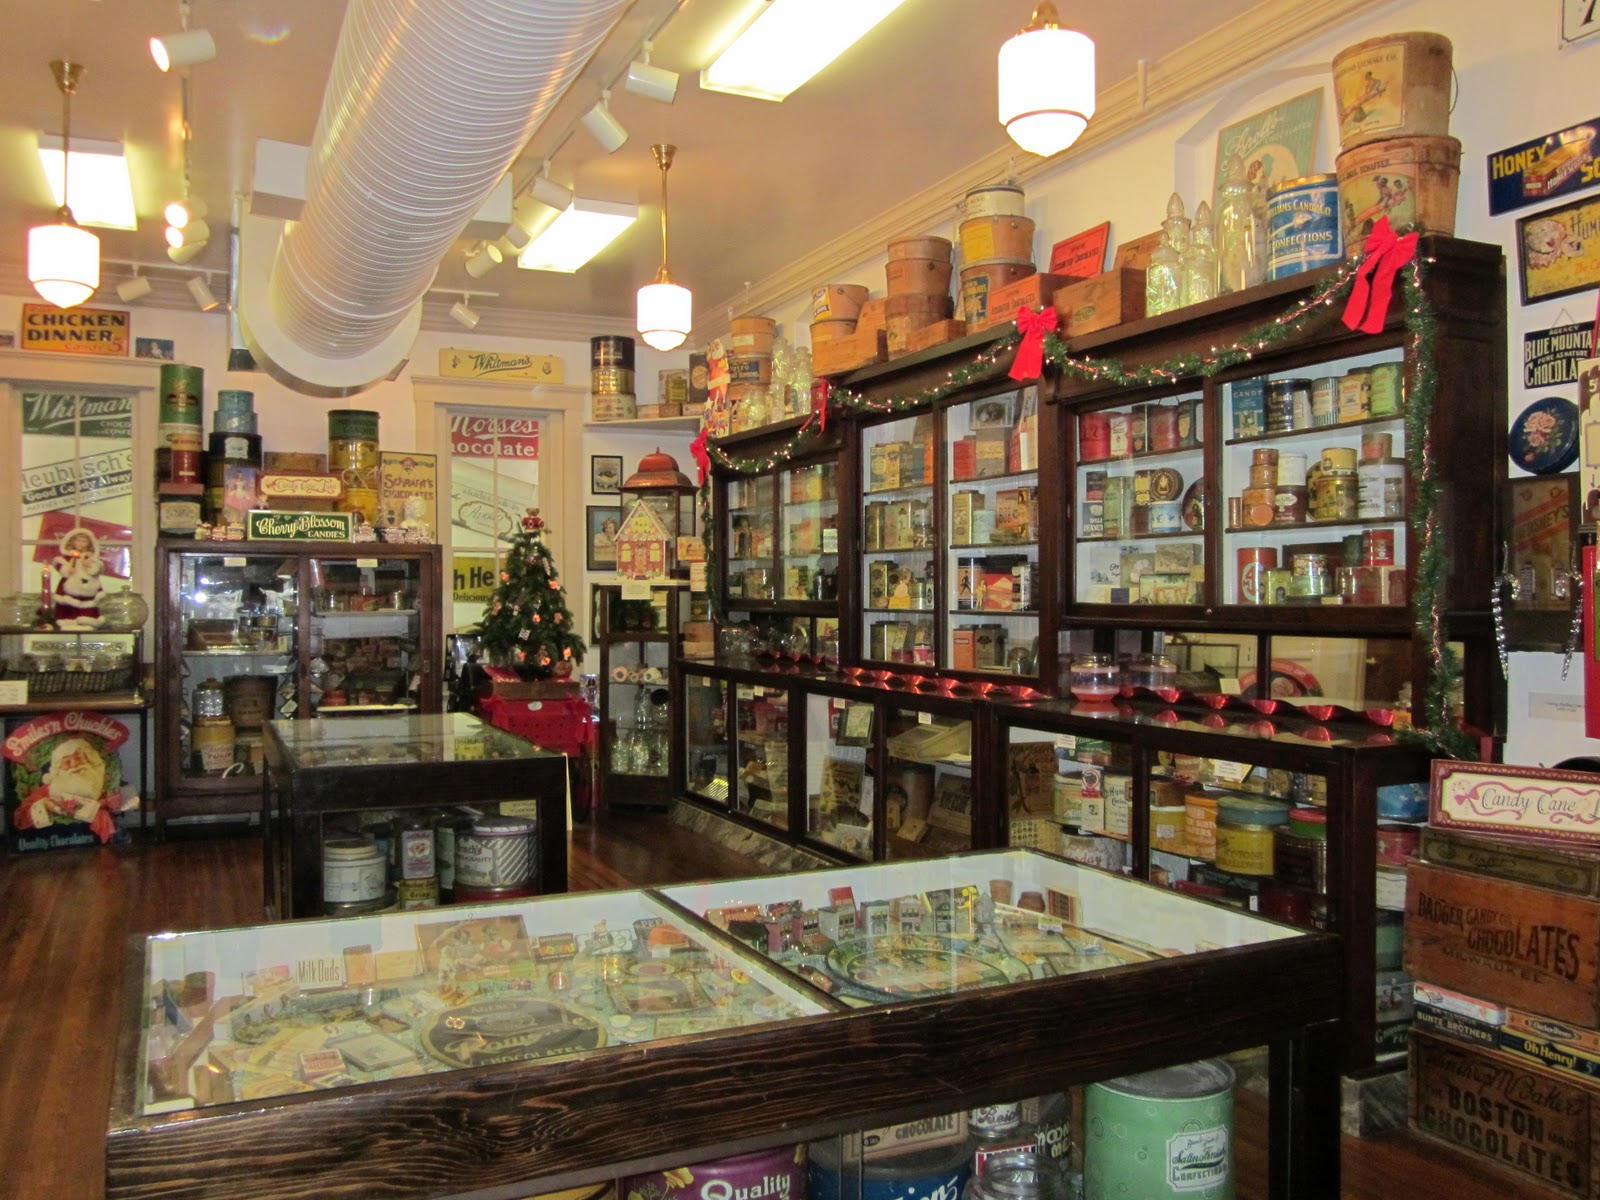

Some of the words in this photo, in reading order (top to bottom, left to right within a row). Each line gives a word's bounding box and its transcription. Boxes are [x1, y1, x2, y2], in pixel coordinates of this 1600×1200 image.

[1493, 143, 1547, 180] HONEY
[1570, 213, 1600, 241] HUM
[1271, 231, 1333, 249] CONFECTIONS
[27, 314, 126, 326] CHICKEN
[1548, 325, 1581, 336] AGENCY
[27, 329, 114, 341] DINNER
[1525, 340, 1550, 363] BLUE
[1551, 330, 1593, 354] MOUNTA
[468, 352, 533, 372] Whitman's
[1537, 353, 1555, 364] PURE
[1232, 389, 1263, 399] CANDY
[25, 489, 57, 503] Good
[59, 480, 97, 495] Cady
[100, 471, 132, 487] Alway
[276, 481, 298, 491] Candy
[467, 504, 505, 521] Apolo
[256, 518, 299, 538] Cherry
[298, 516, 345, 530] Blossom
[307, 530, 346, 538] CANDIES
[454, 569, 465, 590] h
[453, 592, 489, 601] Delicious
[64, 711, 122, 741] Chuckles
[1481, 788, 1530, 815] Candy
[1537, 793, 1577, 815] Cane
[1418, 892, 1464, 932] BADGER
[1467, 920, 1581, 982] CHOCOLATES
[298, 960, 317, 983] Milk
[317, 959, 340, 981] Duds
[1416, 1011, 1443, 1026] BUNTE
[1446, 1020, 1493, 1043] BROTHERS
[1524, 1040, 1539, 1055] Oh
[1540, 1044, 1578, 1068] Henry!
[1448, 1084, 1544, 1143] BOSTON
[895, 1114, 954, 1140] CHOCOLATE
[1424, 1104, 1582, 1187] CHOCOLATES
[701, 1173, 791, 1200] Quality
